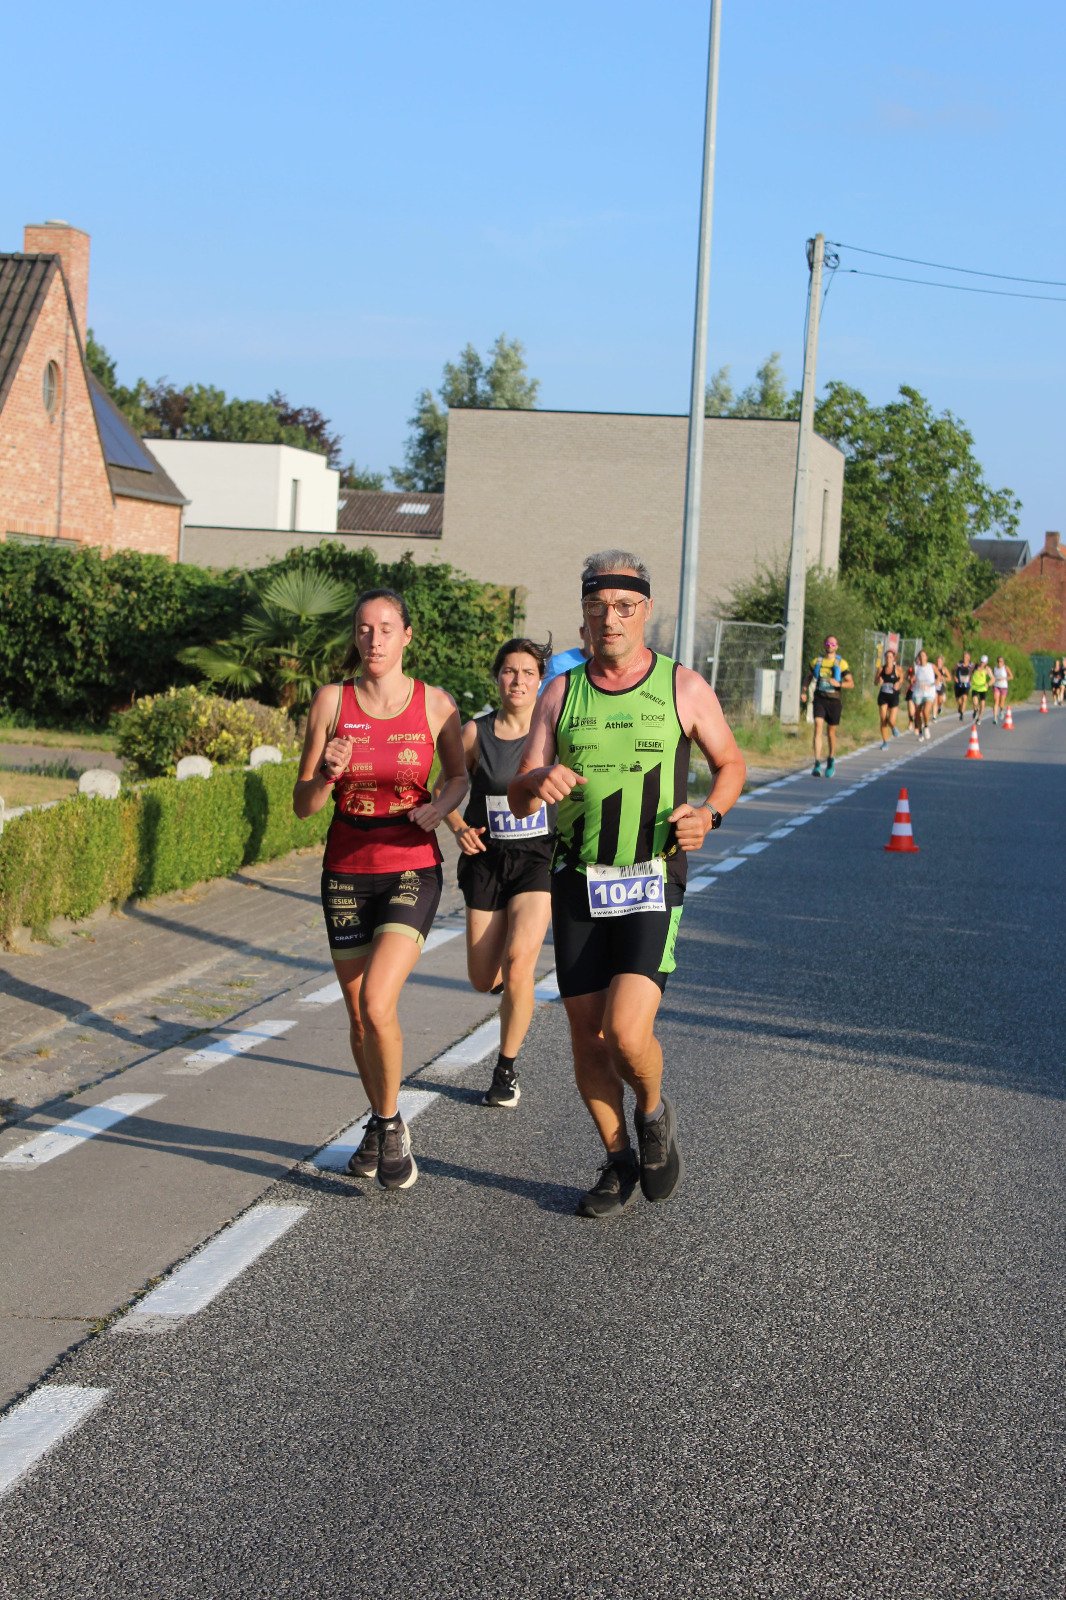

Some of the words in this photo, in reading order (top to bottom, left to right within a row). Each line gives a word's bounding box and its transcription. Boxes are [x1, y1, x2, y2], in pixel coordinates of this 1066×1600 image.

[605, 721, 634, 729] Athlex
[637, 740, 662, 748] FIESIEK
[494, 811, 541, 831] 1117
[594, 880, 660, 905] 1046
